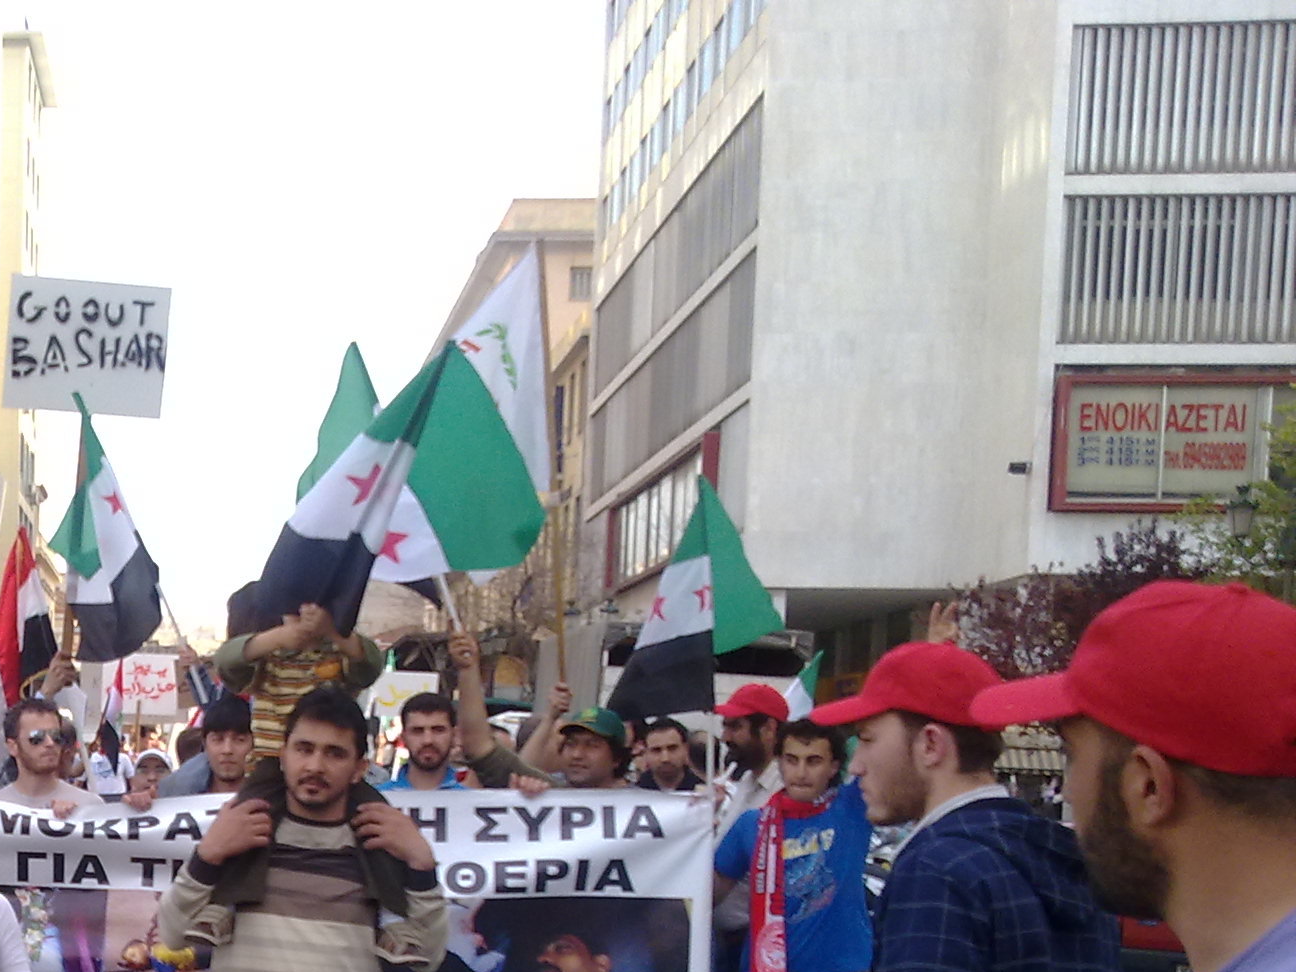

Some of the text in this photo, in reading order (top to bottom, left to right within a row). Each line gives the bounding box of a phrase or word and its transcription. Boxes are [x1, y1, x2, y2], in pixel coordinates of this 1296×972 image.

[11, 329, 165, 378] BASHAR
[473, 805, 665, 842] ΣΥΡΙΑ
[17, 851, 110, 887] ΓΙΑ
